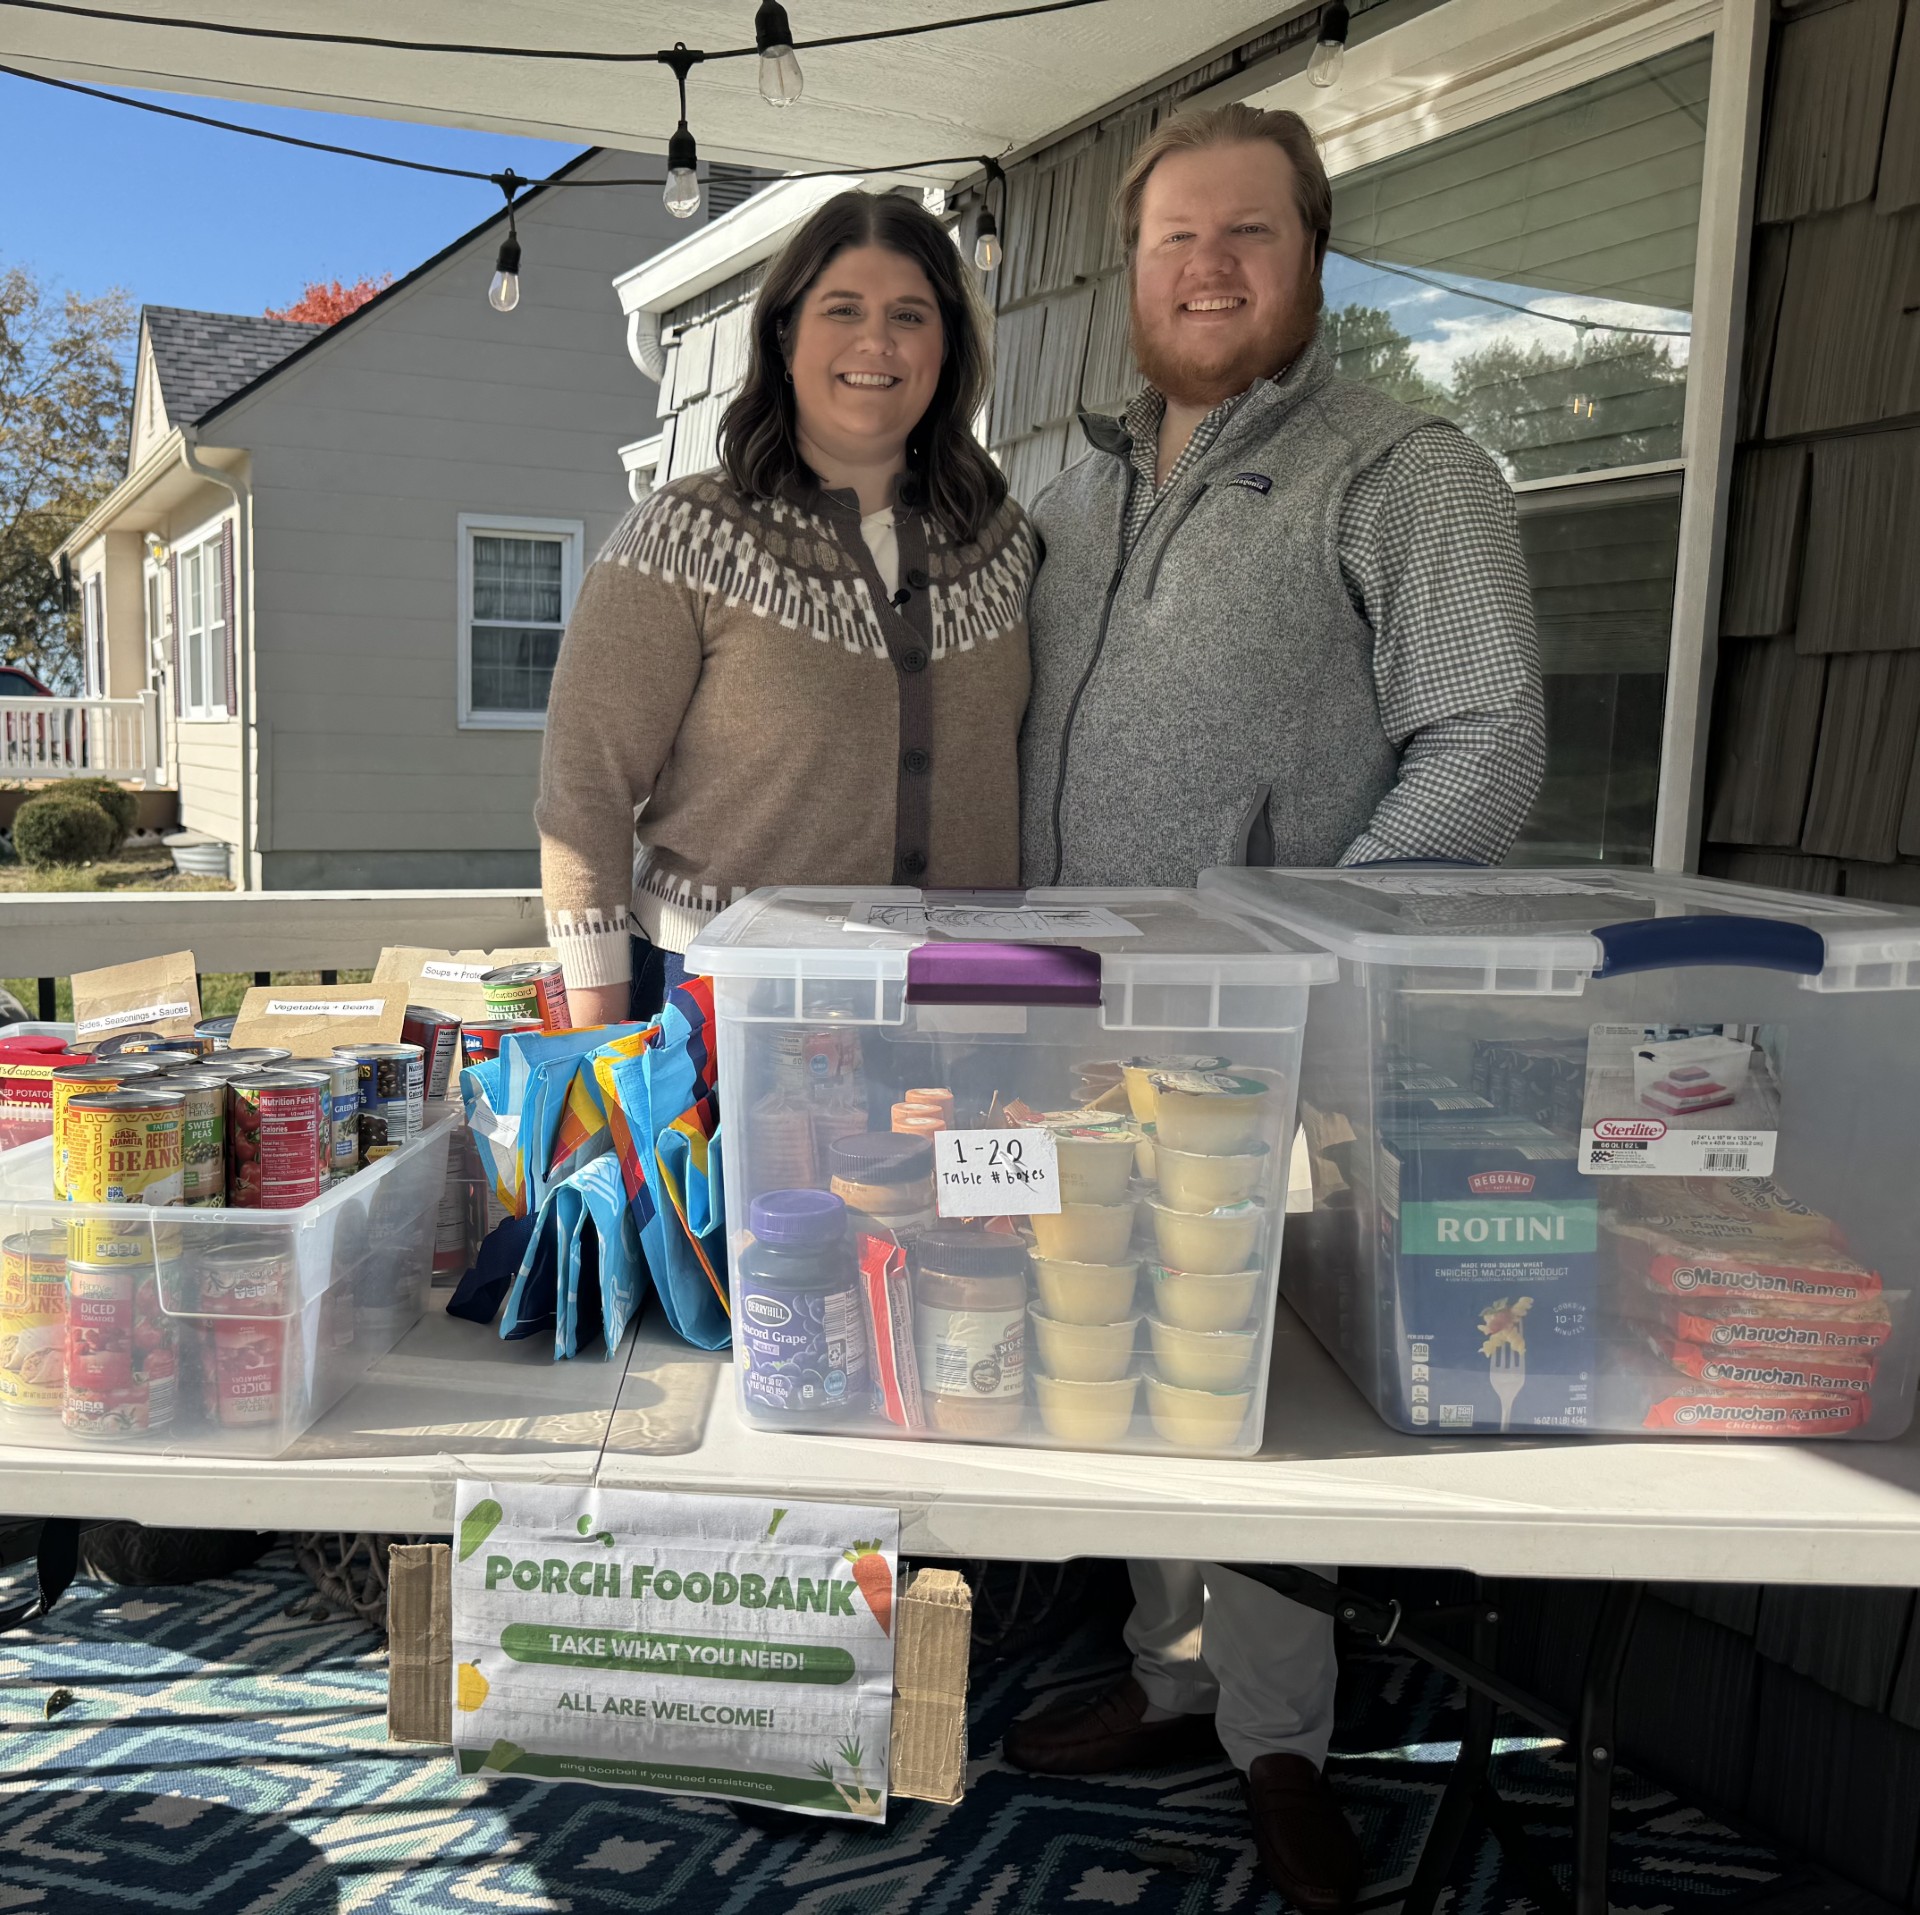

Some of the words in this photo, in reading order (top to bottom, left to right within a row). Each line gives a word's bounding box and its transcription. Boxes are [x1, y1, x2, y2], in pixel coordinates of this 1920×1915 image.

[425, 966, 451, 977] Soups
[79, 1021, 102, 1030] Sides,
[105, 1013, 150, 1026] Seasonings
[159, 1006, 189, 1017] Sauces
[262, 1098, 295, 1106] Nutrition
[296, 1095, 315, 1104] Facts
[335, 1103, 353, 1113] GREEN
[188, 1120, 214, 1130] SWEET
[307, 1121, 316, 1130] 25
[1601, 1122, 1659, 1137] Sterilite
[114, 1130, 137, 1138] CASA
[146, 1131, 178, 1149] REFRIED
[192, 1129, 212, 1139] PEAS
[110, 1138, 142, 1147] MAMITA
[108, 1146, 180, 1172] BEANS
[943, 1170, 982, 1185] Table
[991, 1171, 1000, 1183] #
[1006, 1169, 1045, 1184] boxes
[1474, 1174, 1531, 1188] REGGANO
[1437, 1215, 1565, 1242] ROTINI
[1691, 1220, 1753, 1235] Ramen
[1435, 1268, 1478, 1278] ENRICHED
[1481, 1268, 1527, 1278] MACARONI
[1529, 1267, 1569, 1277] PRODUCT
[1694, 1267, 1789, 1292] Maruchan
[1792, 1280, 1857, 1299] Ramen
[81, 1303, 116, 1315] DICED
[748, 1300, 786, 1320] BERRYHILL
[81, 1314, 115, 1322] TOMATOES
[1556, 1314, 1583, 1324] 10-12
[1554, 1325, 1585, 1336] MINUTES
[1731, 1324, 1818, 1344] Maruchan
[772, 1331, 807, 1345] Grape
[1413, 1345, 1427, 1353] 200
[1719, 1363, 1803, 1386] Maruchan
[1811, 1374, 1870, 1391] Ramen
[232, 1381, 272, 1394] DICED
[1564, 1407, 1575, 1415] NET
[1576, 1407, 1587, 1415] WT
[1697, 1405, 1785, 1422] Maruchan
[1790, 1406, 1851, 1421] Ramen
[1534, 1417, 1541, 1425] 16
[1542, 1417, 1551, 1425] OZ
[1559, 1417, 1570, 1425] LB)
[1725, 1421, 1773, 1431] Chicken
[485, 1555, 621, 1599] PORCH
[631, 1565, 858, 1617] FOODBANK
[549, 1633, 606, 1657] TAKE
[611, 1638, 680, 1662] WHAT
[685, 1644, 735, 1667] YOU
[740, 1649, 805, 1671] NEED!
[557, 1692, 597, 1713] ALL
[601, 1697, 646, 1717] ARE
[651, 1700, 775, 1728] WELCOME!
[560, 1762, 586, 1773] Ring
[588, 1764, 637, 1777] Doorbell
[650, 1772, 672, 1780] you
[675, 1774, 706, 1784] need
[708, 1776, 776, 1792] assistance.
